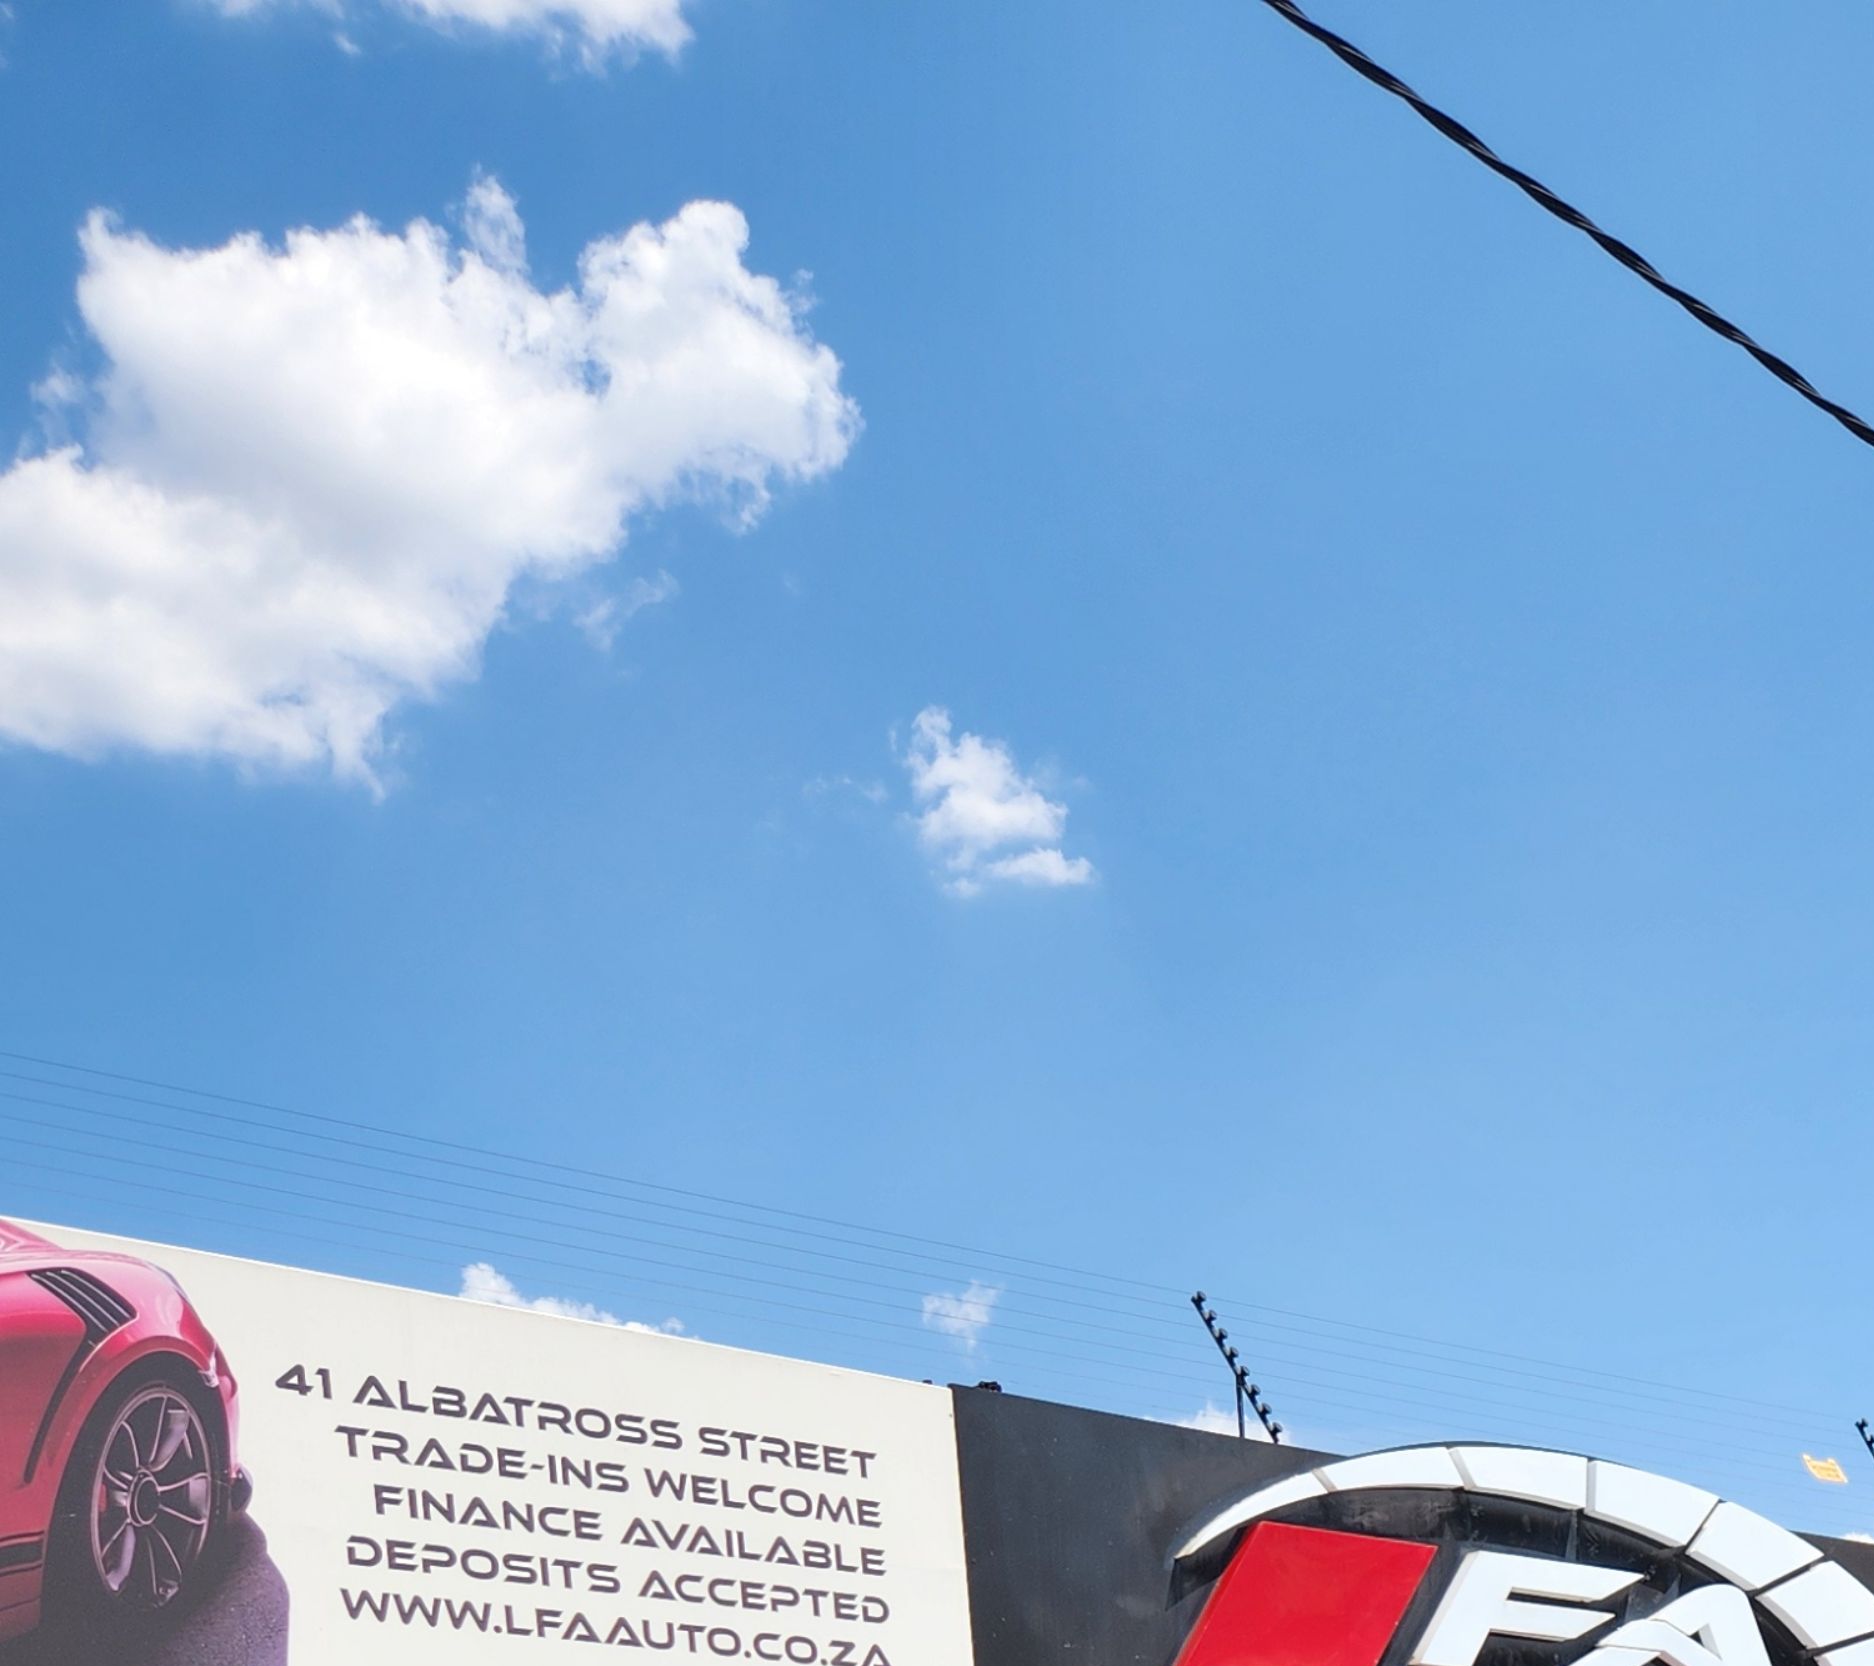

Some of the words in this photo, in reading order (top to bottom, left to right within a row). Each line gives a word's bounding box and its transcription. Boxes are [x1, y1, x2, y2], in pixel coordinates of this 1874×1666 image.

[275, 1364, 333, 1399] 41
[353, 1375, 682, 1450] ALBATROSS
[698, 1428, 877, 1479] STREET
[335, 1425, 629, 1493] TRADE-INS
[644, 1467, 882, 1529] WELCOME
[374, 1484, 602, 1541] FINANCE
[620, 1516, 886, 1577] AVAILABLE
[346, 1536, 619, 1594] DEPOSITS
[638, 1570, 890, 1624] ACCEPTED
